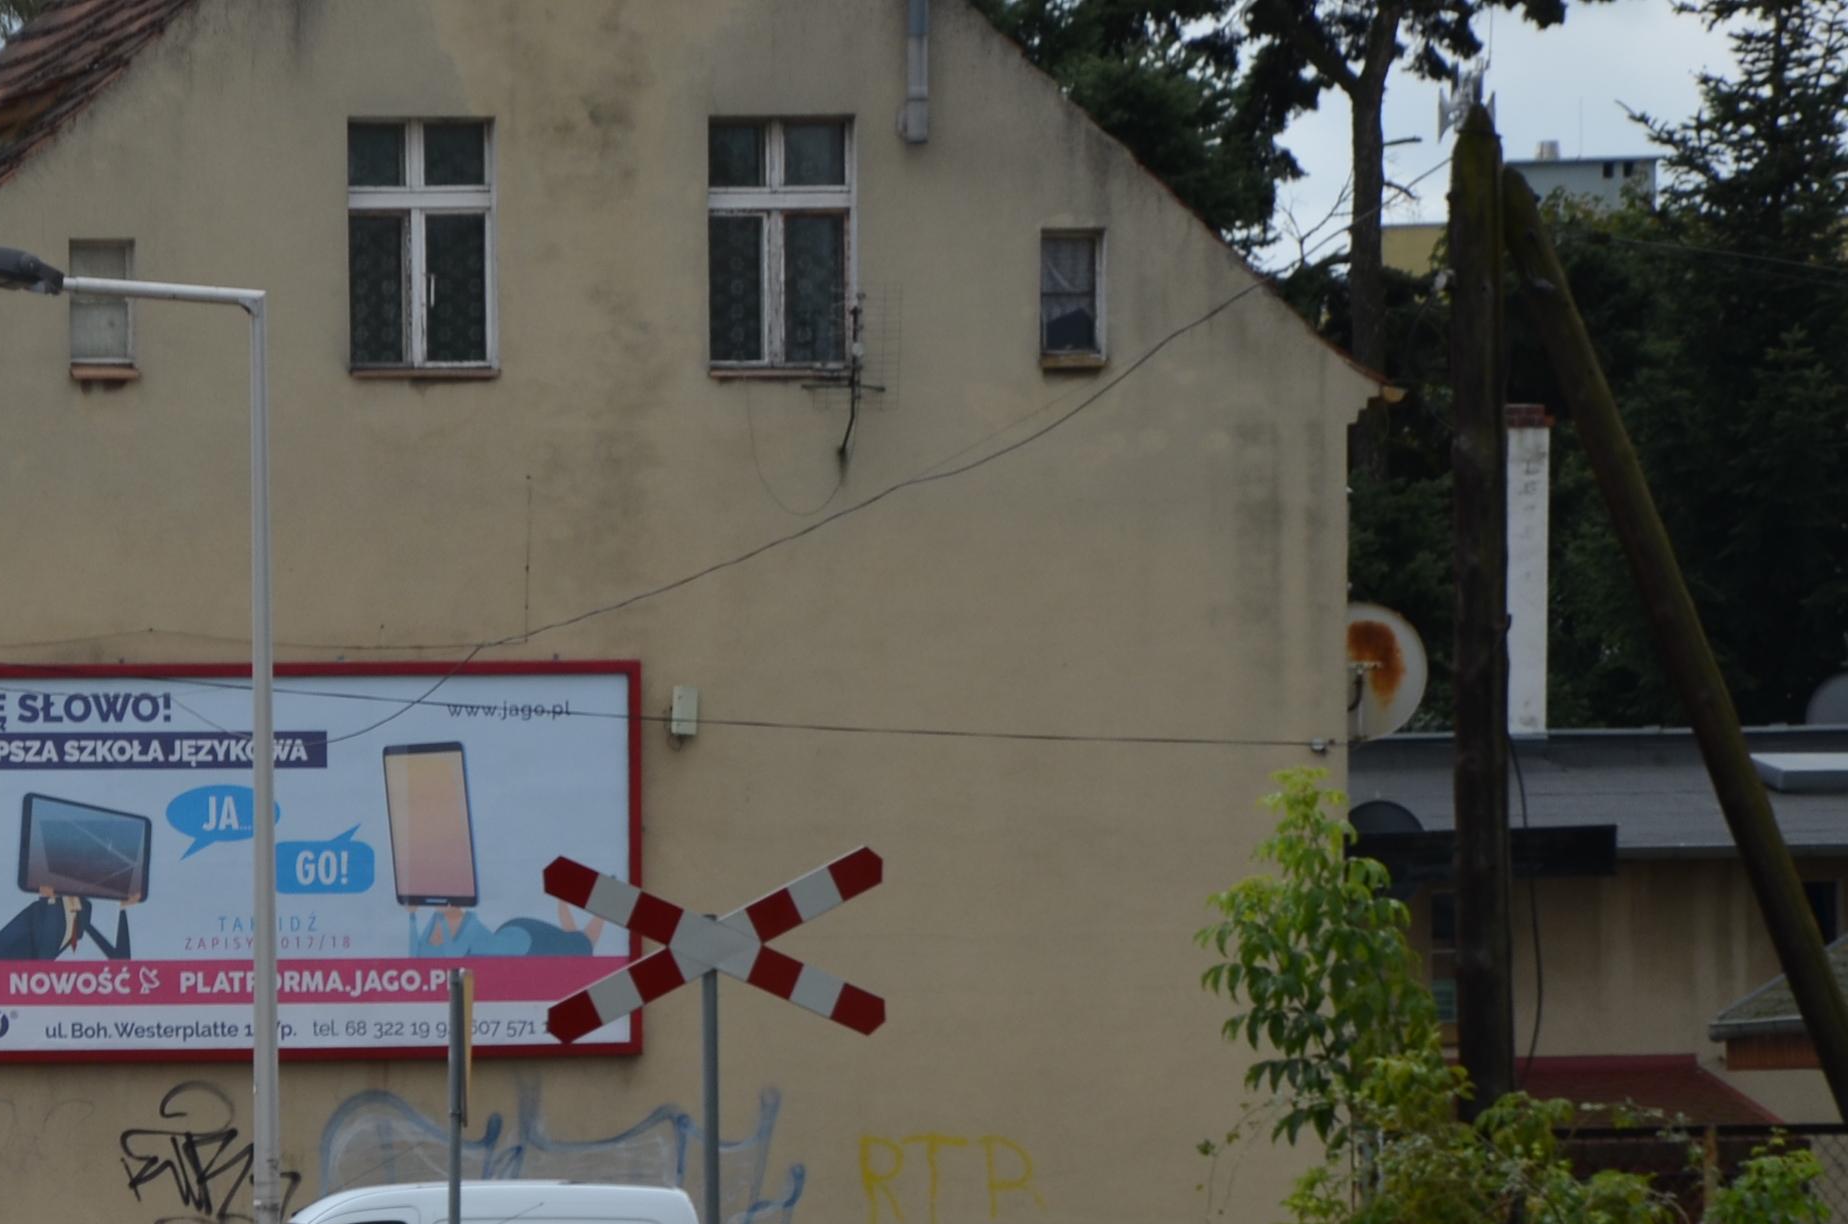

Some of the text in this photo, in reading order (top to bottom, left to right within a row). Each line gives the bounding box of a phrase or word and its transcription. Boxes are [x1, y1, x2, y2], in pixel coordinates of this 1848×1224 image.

[18, 692, 172, 724] SŁOWO!
[447, 700, 570, 721] www.jago.pl
[64, 739, 164, 763] SZKOŁA
[295, 850, 349, 886] GO!
[280, 935, 351, 950] 017/18
[9, 966, 130, 996] NOWOŚĆ
[45, 1022, 68, 1039] ul.
[71, 1022, 112, 1039] Boh.
[114, 1021, 239, 1043] Westerplatte
[313, 1019, 339, 1037] tel.
[345, 1020, 367, 1037] 68
[373, 1022, 404, 1039] 322
[411, 1021, 430, 1039] 19
[506, 1020, 536, 1038] 571
